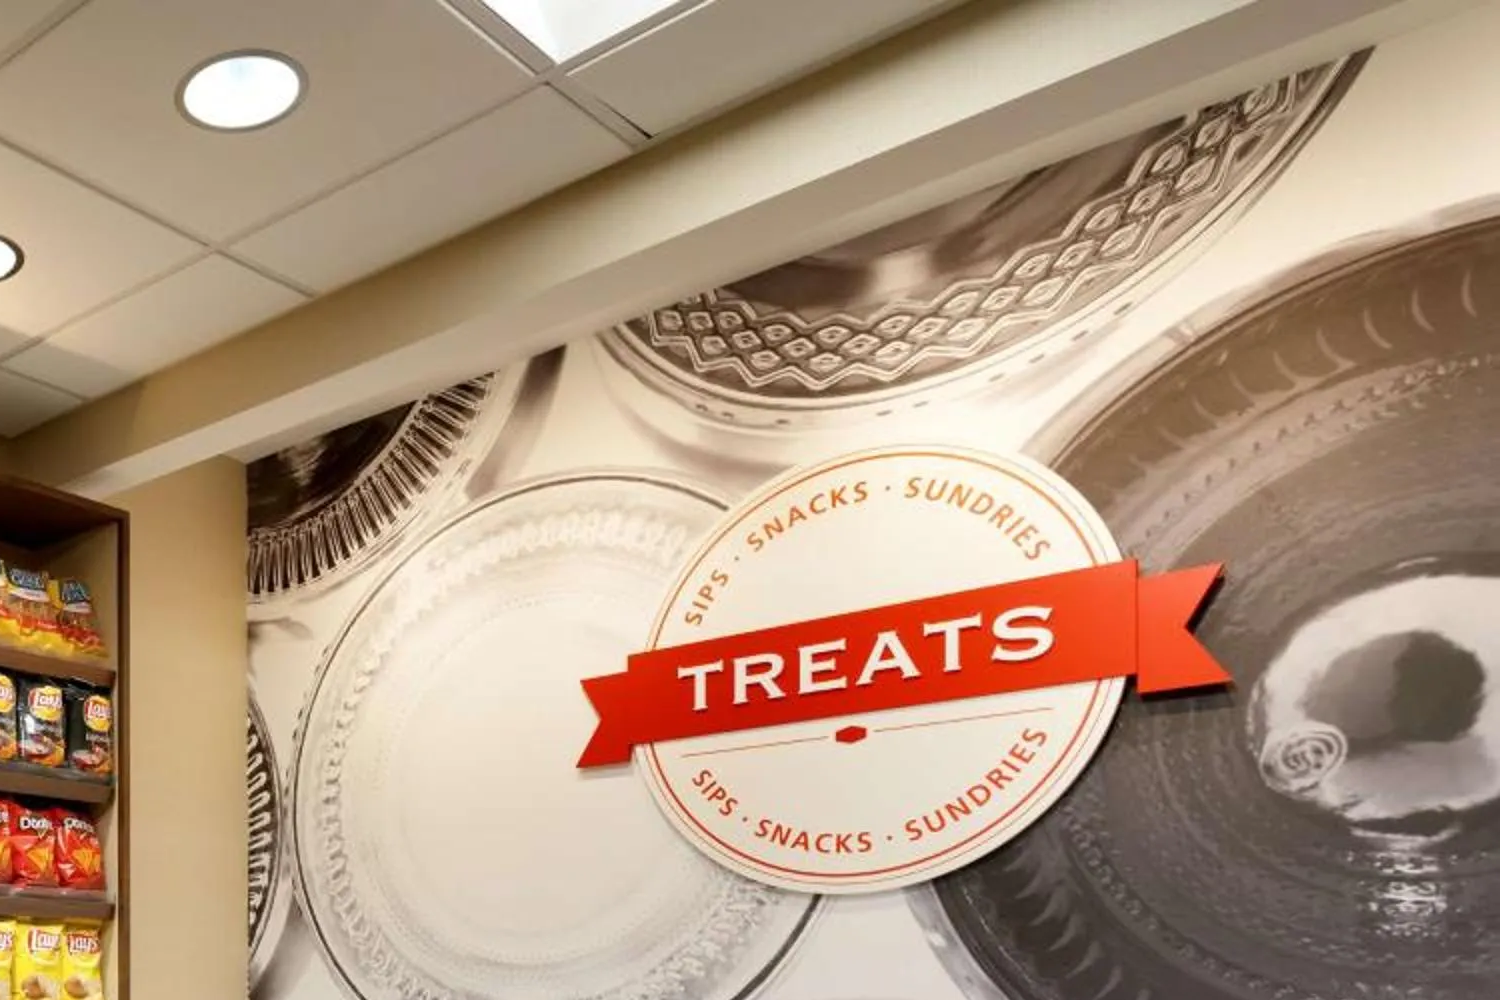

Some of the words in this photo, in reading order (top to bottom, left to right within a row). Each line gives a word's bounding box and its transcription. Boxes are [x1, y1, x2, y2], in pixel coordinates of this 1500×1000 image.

[685, 568, 729, 627] SIPS
[746, 479, 870, 553] SNACKS
[903, 475, 1052, 562] SUNDRIES
[676, 604, 1055, 712] TREATS
[691, 768, 739, 818] SIPS
[753, 817, 874, 855] SNACKS
[903, 726, 1048, 842] SUNDRIES
